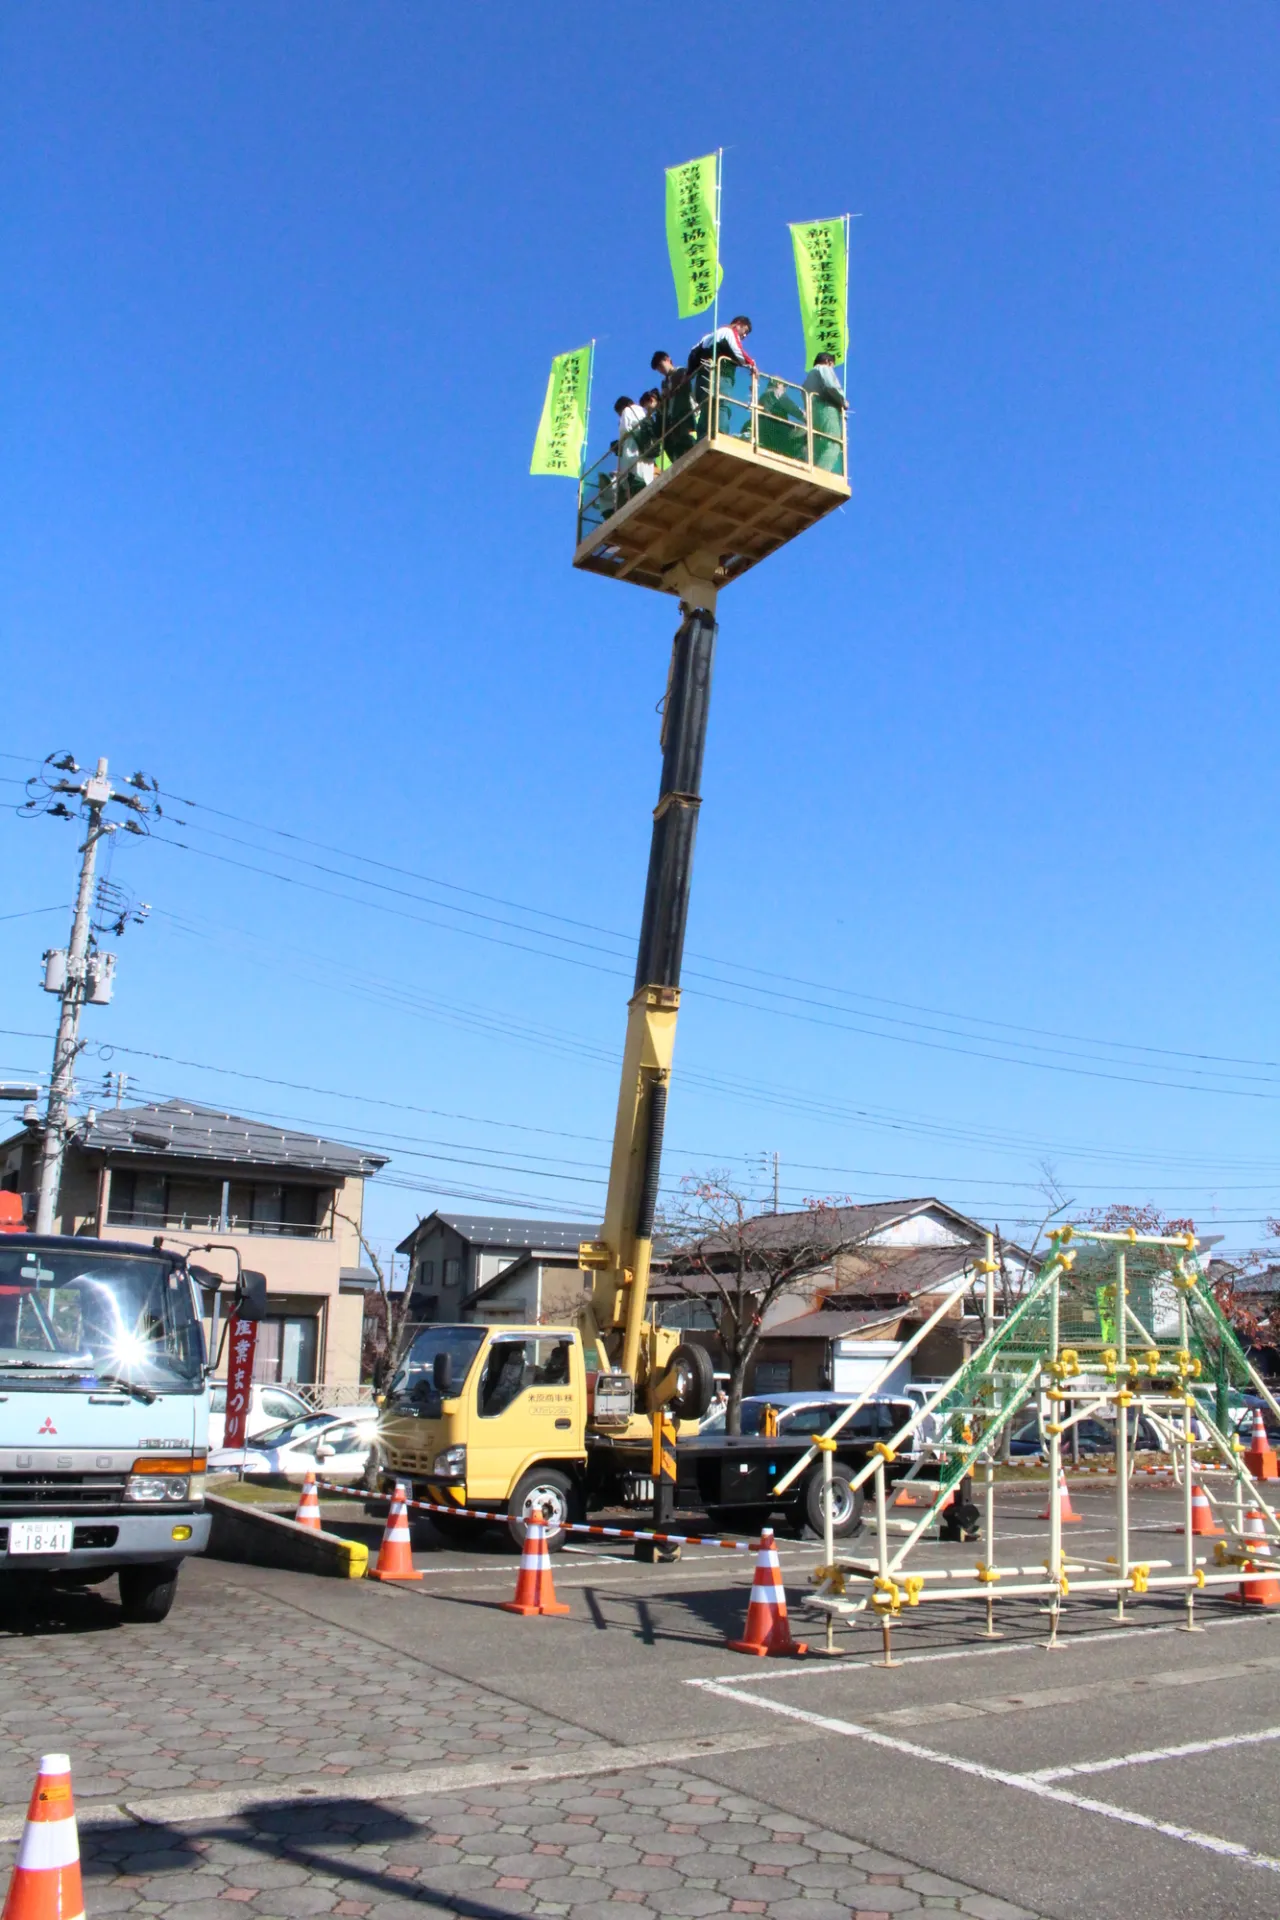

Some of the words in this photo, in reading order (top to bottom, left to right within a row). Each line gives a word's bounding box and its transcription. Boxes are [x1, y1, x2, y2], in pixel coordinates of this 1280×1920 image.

[228, 1319, 253, 1438] 産業まつり
[26, 1534, 66, 1551] 18-41
